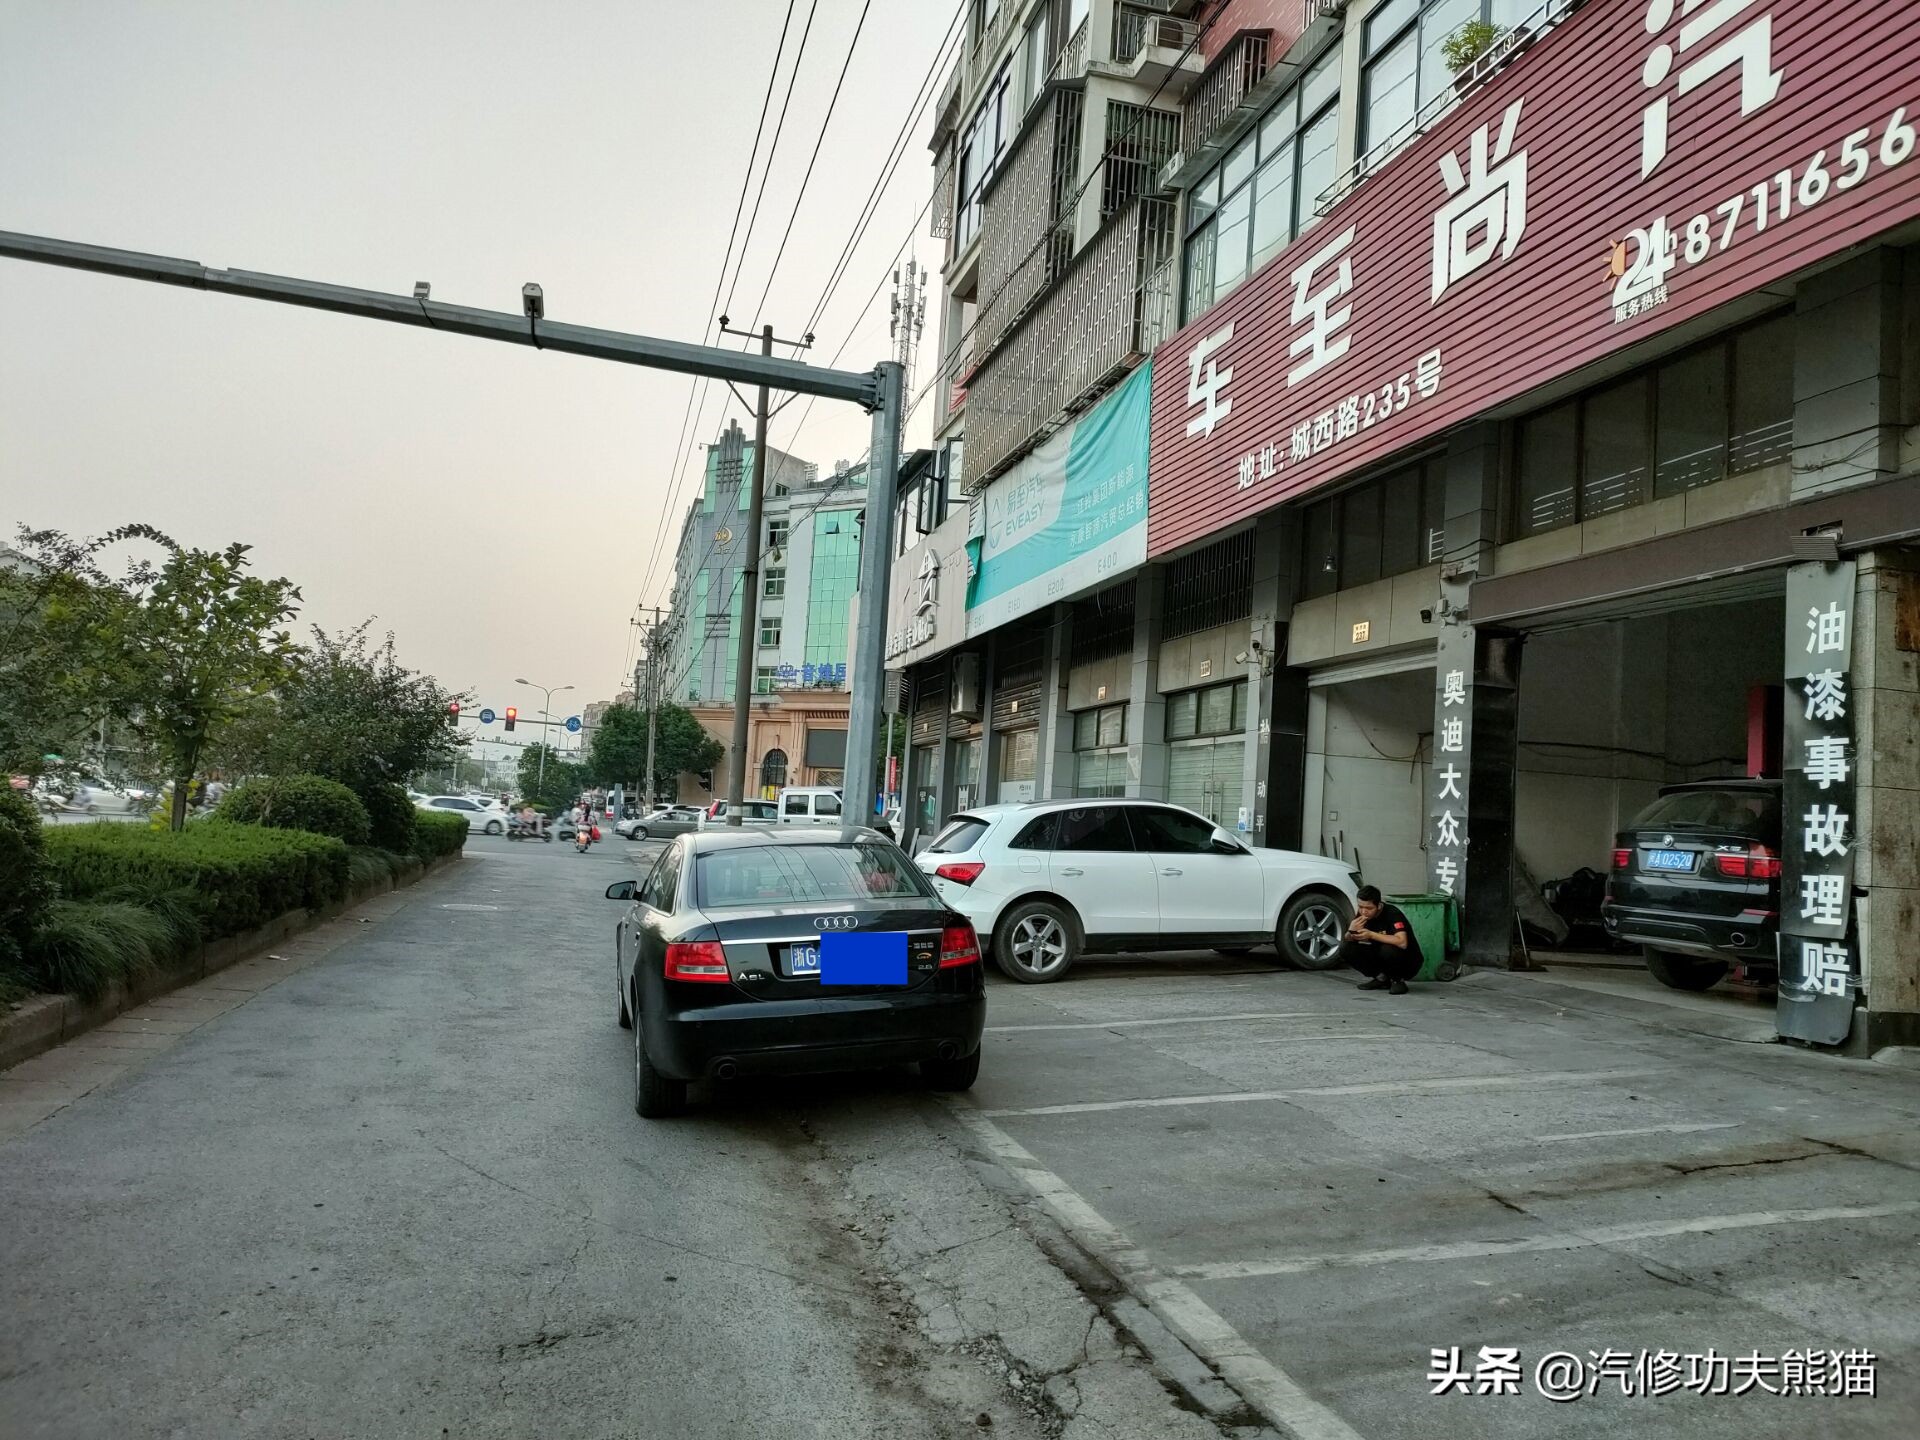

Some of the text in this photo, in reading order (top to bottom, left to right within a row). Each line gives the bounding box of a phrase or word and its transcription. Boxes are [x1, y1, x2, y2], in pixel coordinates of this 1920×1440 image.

[1684, 107, 1916, 265] 8711656
[1614, 284, 1669, 325] 服务热线
[1006, 499, 1046, 536] EVEASY
[1435, 669, 1467, 898] 奥迪大众专
[1800, 601, 1851, 998] 油漆事故理赔
